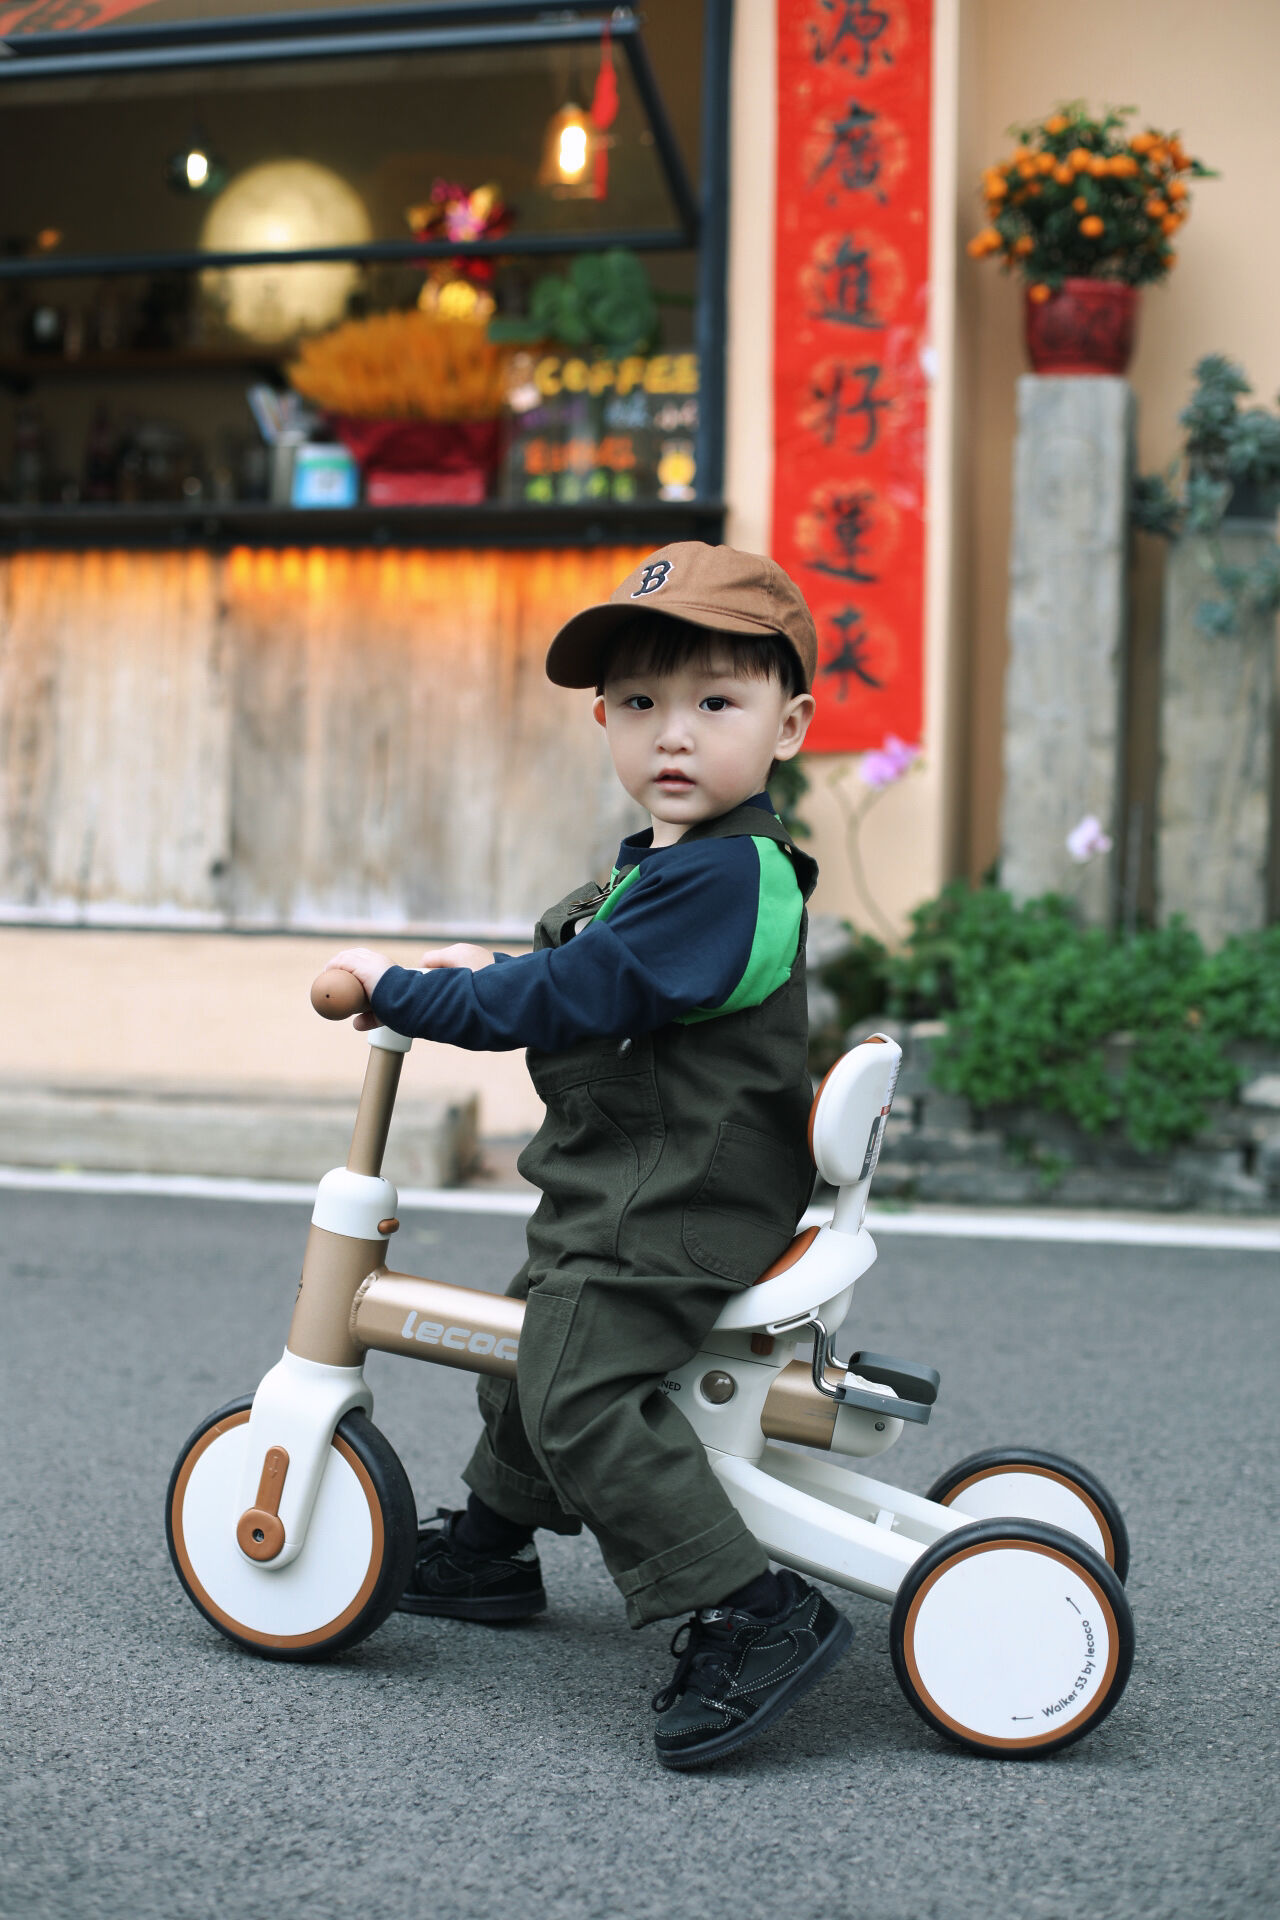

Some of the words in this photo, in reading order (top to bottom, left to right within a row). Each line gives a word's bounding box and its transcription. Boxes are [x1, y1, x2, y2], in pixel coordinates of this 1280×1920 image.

[534, 353, 698, 395] COFFEE
[631, 560, 675, 598] B
[1082, 1620, 1095, 1658] lecoco
[1074, 1676, 1088, 1690] S3
[1081, 1660, 1096, 1675] by
[1041, 1690, 1078, 1717] Walker
